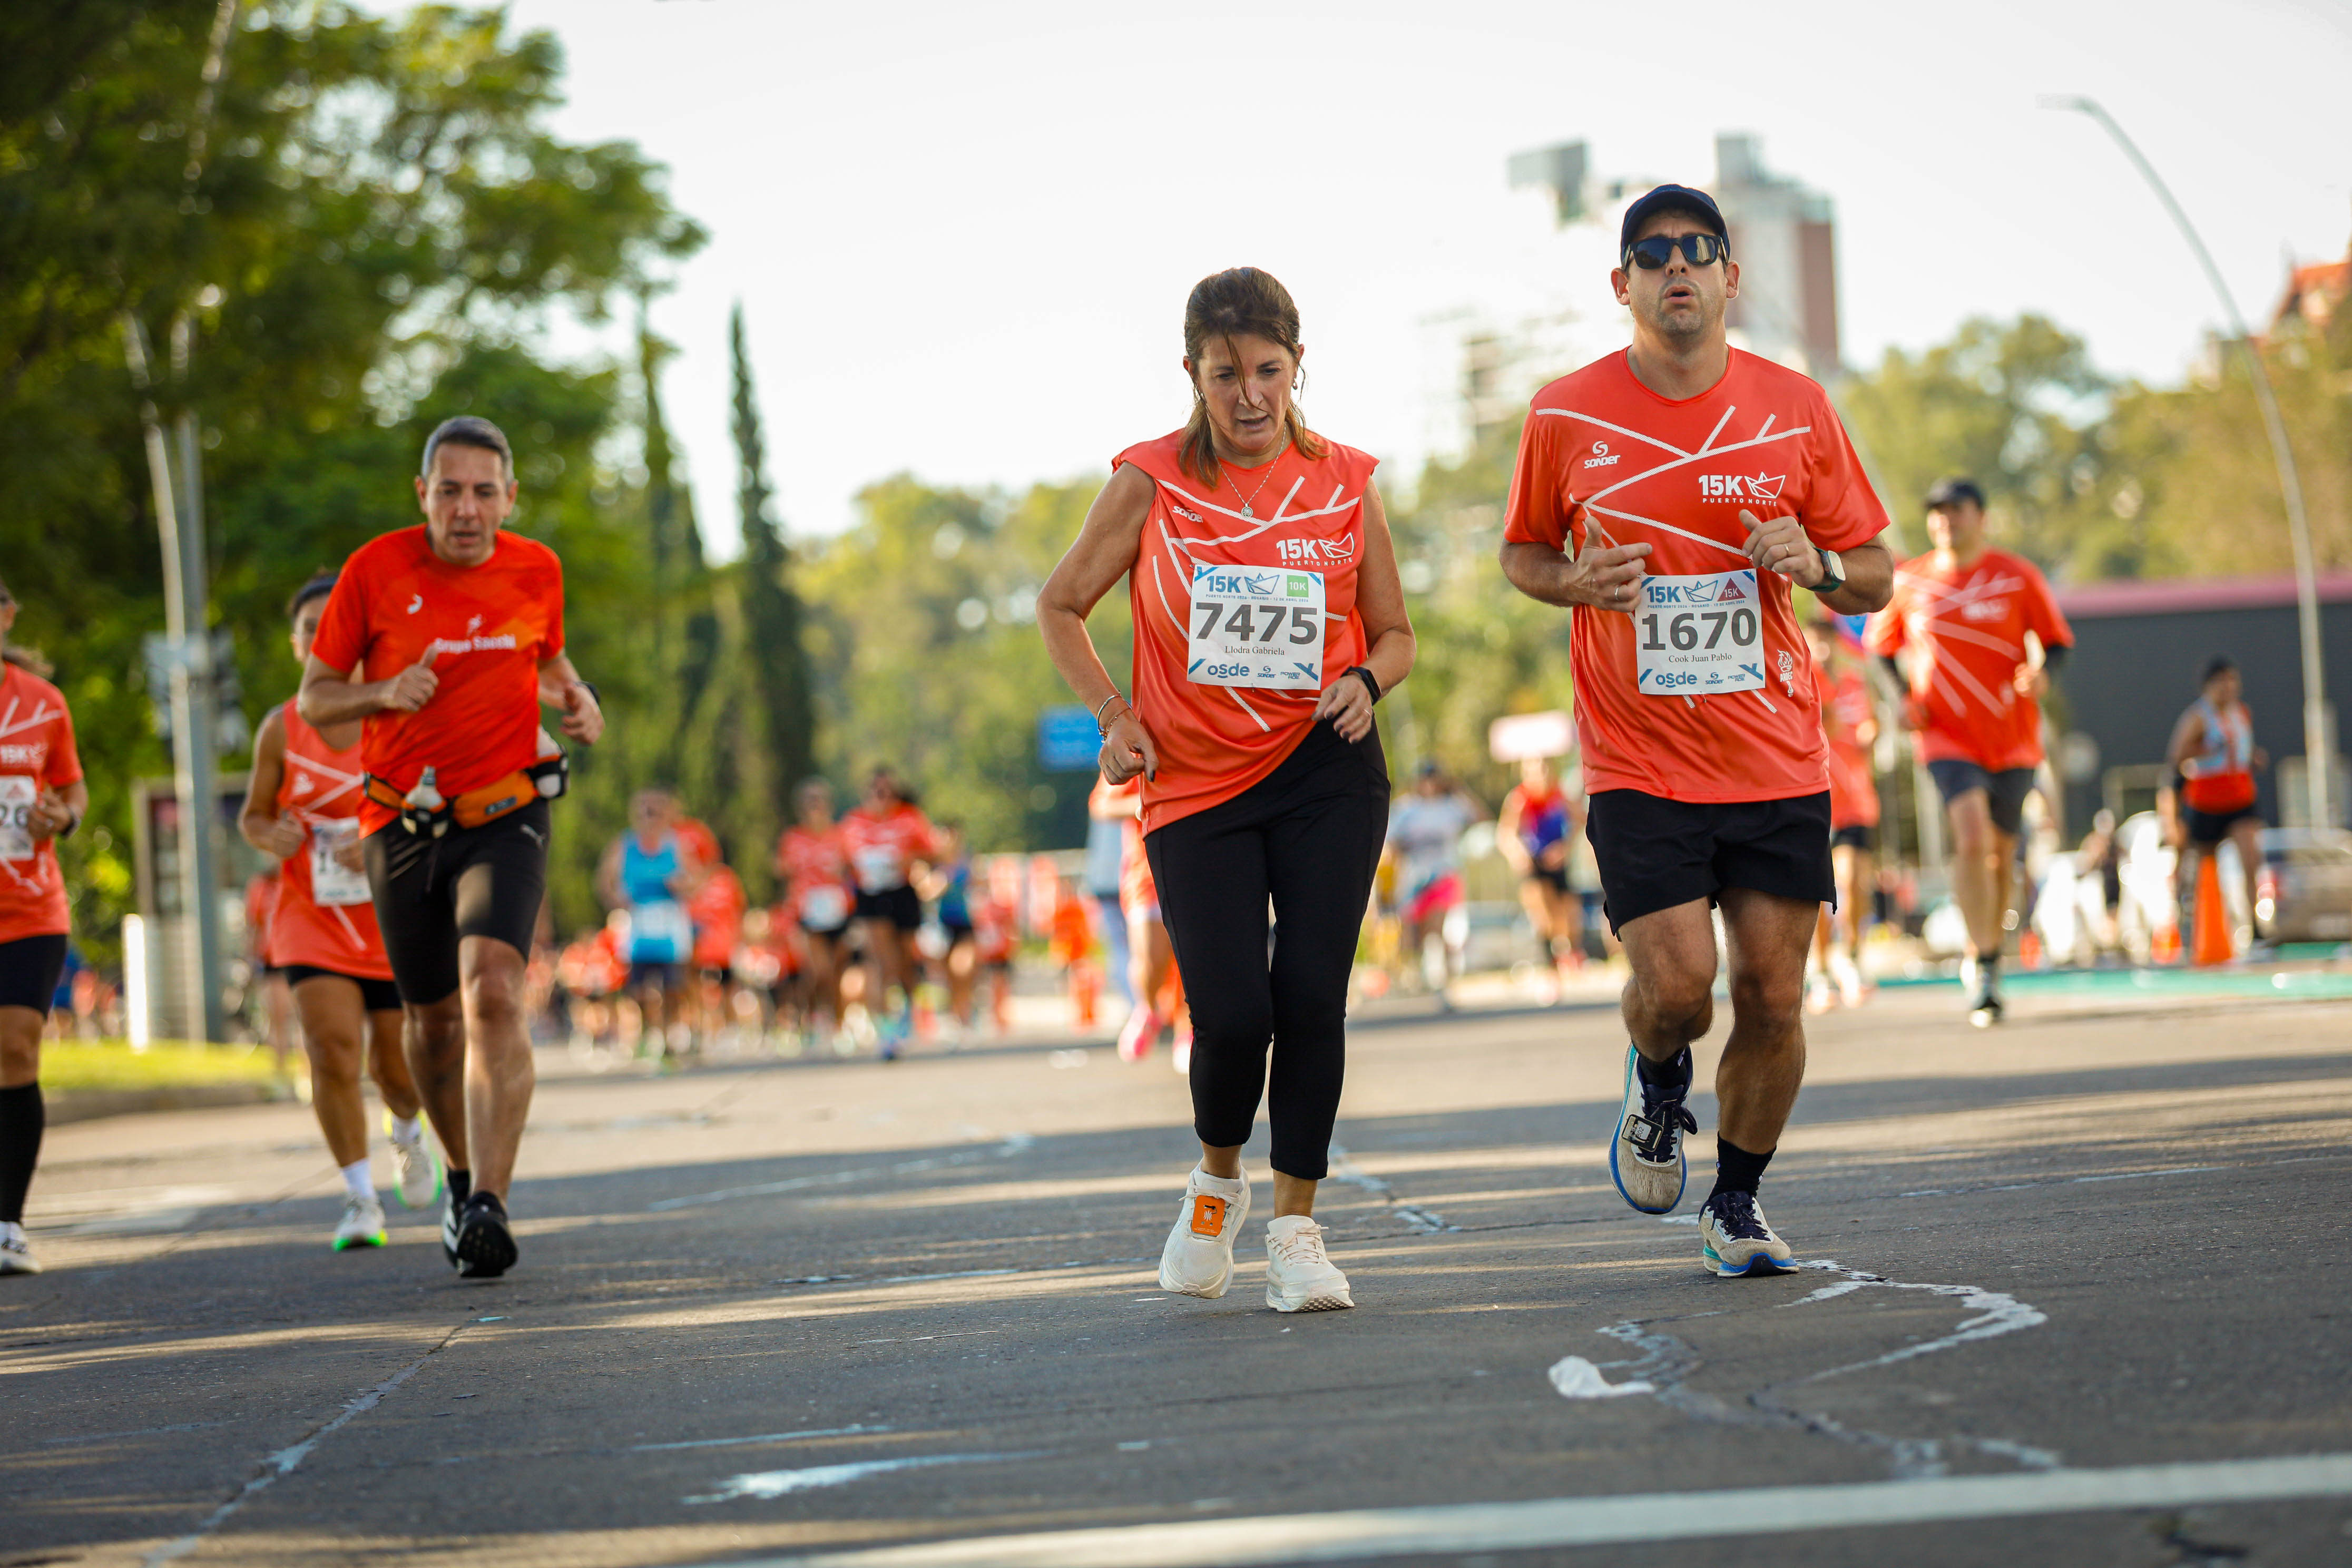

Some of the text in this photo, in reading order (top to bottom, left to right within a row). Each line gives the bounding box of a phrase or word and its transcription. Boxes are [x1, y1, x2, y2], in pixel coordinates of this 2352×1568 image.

[1698, 474, 1744, 496] 15K
[1276, 538, 1319, 560] 15K
[1324, 557, 1353, 566] NORTE
[1207, 575, 1242, 593] 15K
[1289, 581, 1307, 591] 10K
[1647, 586, 1681, 603] 15K
[1724, 588, 1739, 598] 15K
[1195, 602, 1318, 645] 7475
[1642, 608, 1757, 651] 1670
[1252, 646, 1285, 655] Gabriela
[1207, 662, 1250, 678] osde
[1655, 671, 1698, 688] osde
